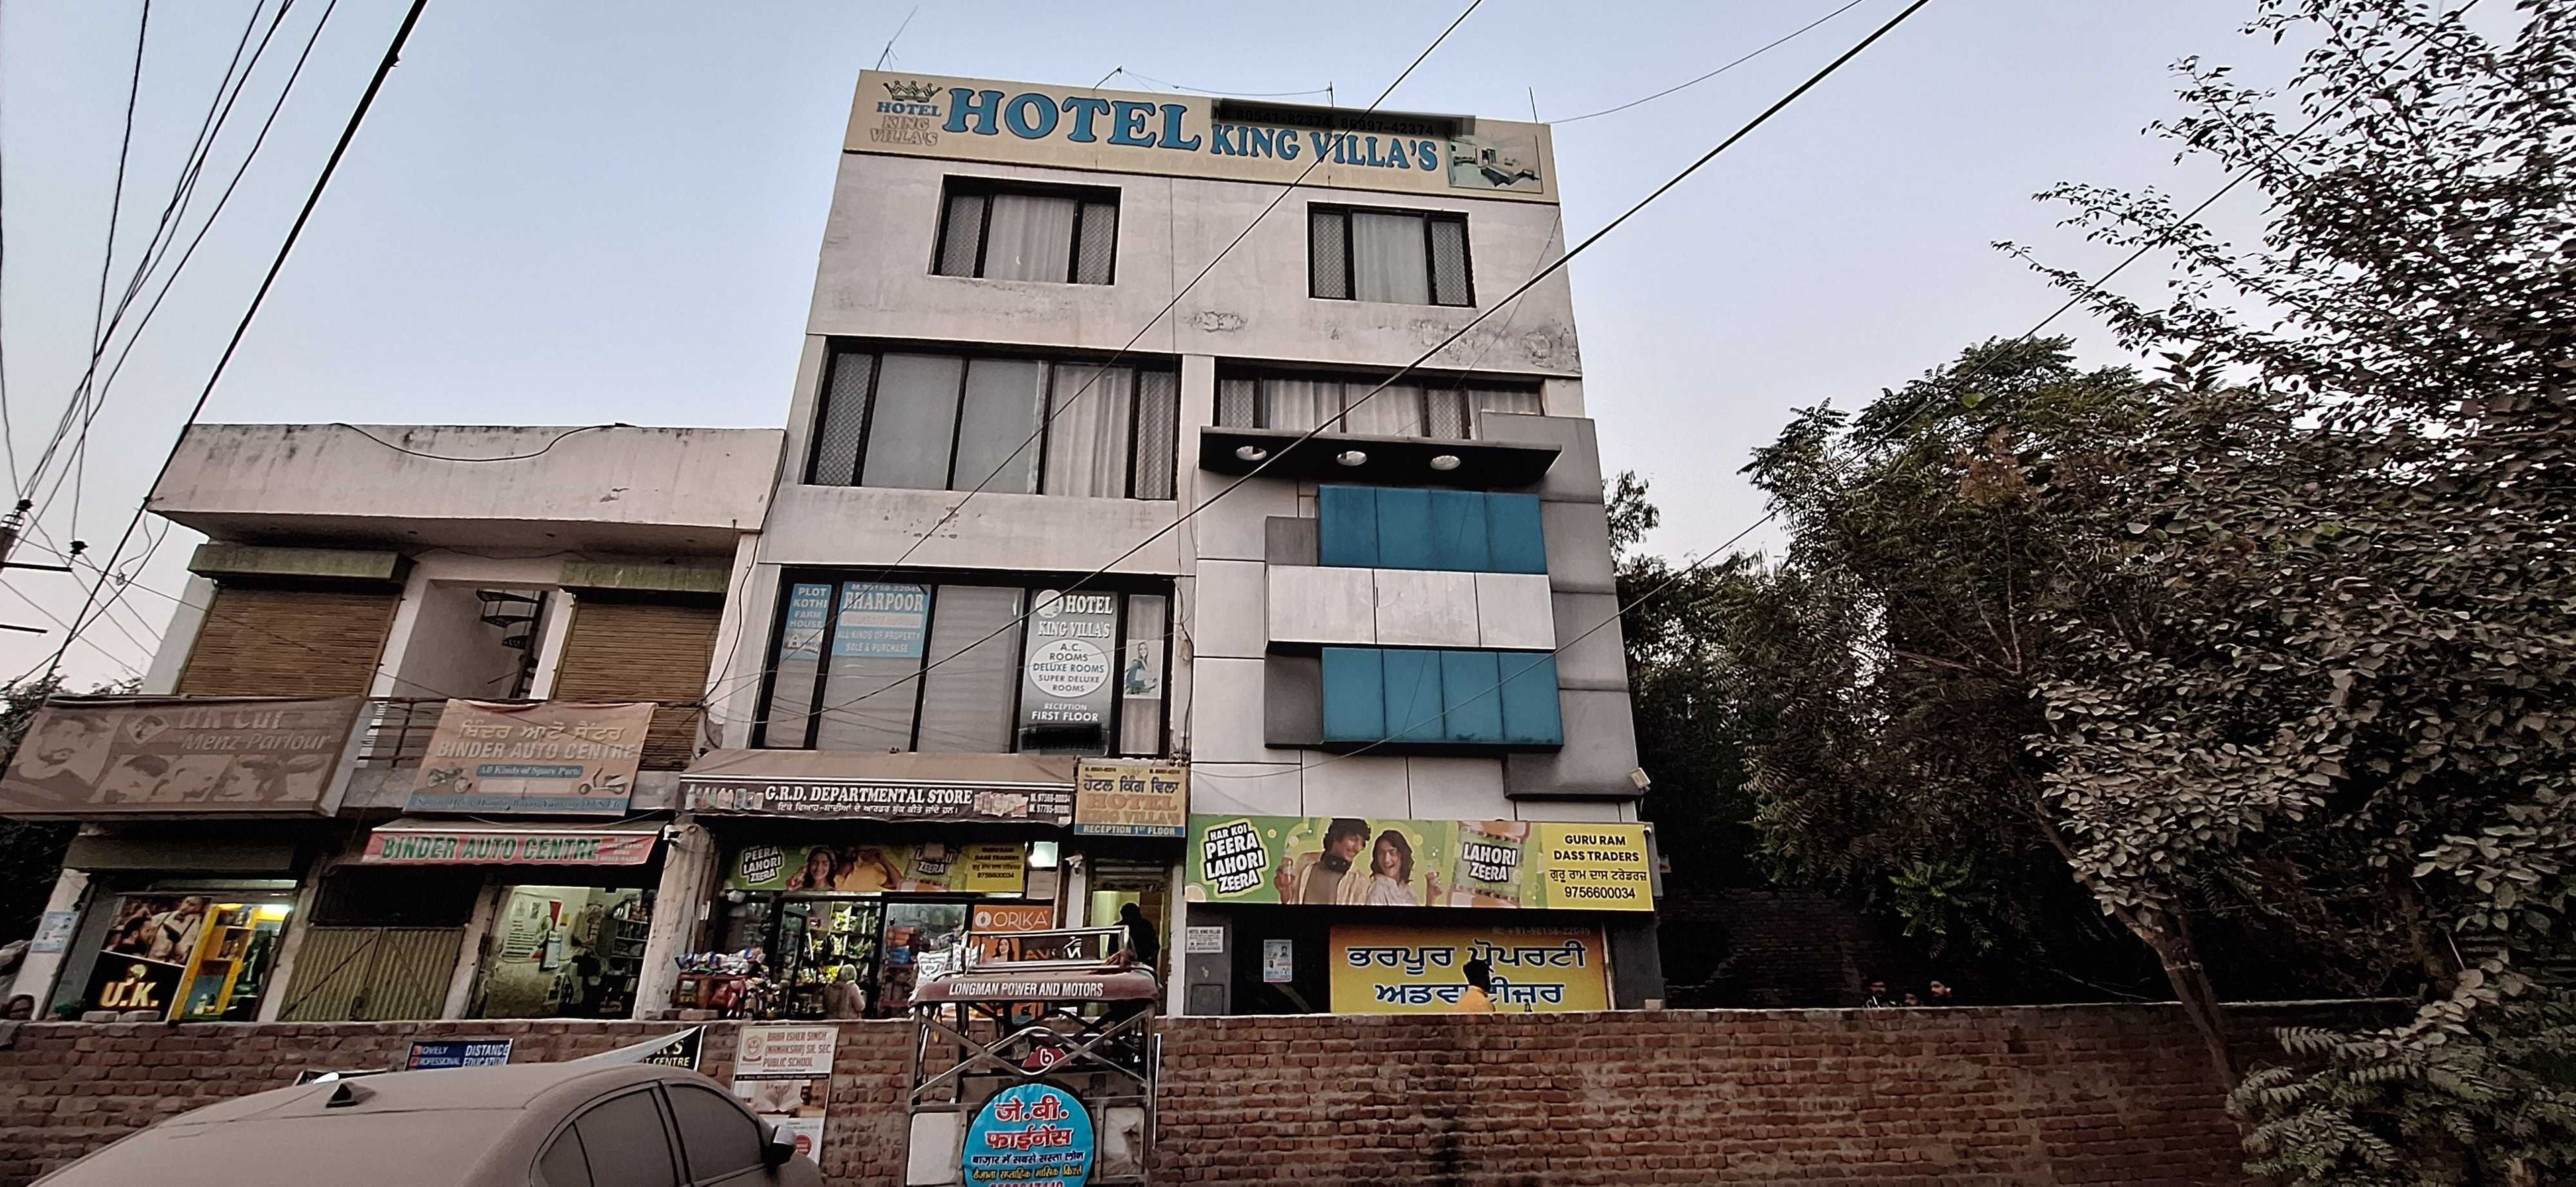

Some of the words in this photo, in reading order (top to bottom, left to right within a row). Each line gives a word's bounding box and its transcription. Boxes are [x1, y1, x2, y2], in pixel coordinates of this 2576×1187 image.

[876, 102, 942, 117] HOTEL
[881, 115, 930, 131] KING
[942, 87, 1202, 152] HOTEL
[870, 128, 938, 146] VILLA'S
[1210, 124, 1300, 160] KING
[1309, 131, 1438, 172] VILLA'S
[799, 587, 826, 596] PLOT
[793, 599, 827, 608] KOTHI
[843, 591, 924, 611] BHARPOOR
[1065, 595, 1113, 614] HOTEL
[790, 620, 825, 628] HOUSE
[1038, 621, 1067, 637] KING
[1060, 643, 1081, 651] A.C.
[1049, 653, 1088, 661] ROOMS
[1033, 664, 1067, 672] DELUXE
[1071, 665, 1104, 673] ROOMS
[1068, 675, 1100, 683] DELUXE
[1032, 711, 1059, 720] FIRST
[1063, 712, 1098, 722] FLOOR
[180, 733, 240, 750] Menz
[246, 732, 331, 750] Parlour
[436, 740, 504, 758] BINDER
[509, 742, 559, 760] AUTO
[564, 742, 636, 760] CENTRE
[765, 786, 806, 801] G.R.D.
[810, 787, 924, 803] DEPARTMENTAL
[927, 789, 972, 804] STORE
[1086, 793, 1177, 811] HOTEL
[1083, 825, 1131, 834] RECEPTION
[1148, 826, 1175, 834] FLOOR
[1210, 829, 1229, 842] HAR
[1230, 824, 1248, 837] KOI
[1206, 833, 1258, 859] PEERA
[1564, 834, 1597, 845] GURU
[1599, 836, 1626, 846] RAM
[381, 836, 458, 860] BINDER
[461, 836, 517, 860] AUTO
[522, 837, 601, 861] CENTRE
[745, 846, 778, 862] PEERA
[1462, 843, 1518, 866] LAHORI
[1554, 850, 1585, 860] DASS
[1587, 851, 1639, 862] TRADERS
[743, 856, 781, 874] LAHORI
[918, 862, 945, 873] ZEERA
[1205, 850, 1265, 879] LAHORI
[1470, 862, 1508, 881] ZEERA
[750, 868, 775, 882] ZEERA
[1218, 870, 1258, 893] ZEERA
[1564, 886, 1635, 899] 9756600034
[994, 911, 1047, 930] ORIKA
[1346, 946, 1456, 975] ਭਰਪੂਰ
[99, 981, 160, 1008] U.K.
[949, 982, 999, 996] LONGMAN
[1001, 982, 1037, 997] POWER
[1038, 983, 1059, 997] AND
[1063, 982, 1104, 997] MOTORS
[465, 1044, 510, 1056] DISTANCE
[653, 1057, 690, 1066] CENTRE
[763, 1058, 786, 1067] PUBLIC
[788, 1057, 813, 1066] SCHOOL
[1013, 1153, 1036, 1164] सबसे
[1039, 1153, 1062, 1163] सस्ता
[1065, 1151, 1084, 1160] लोन
